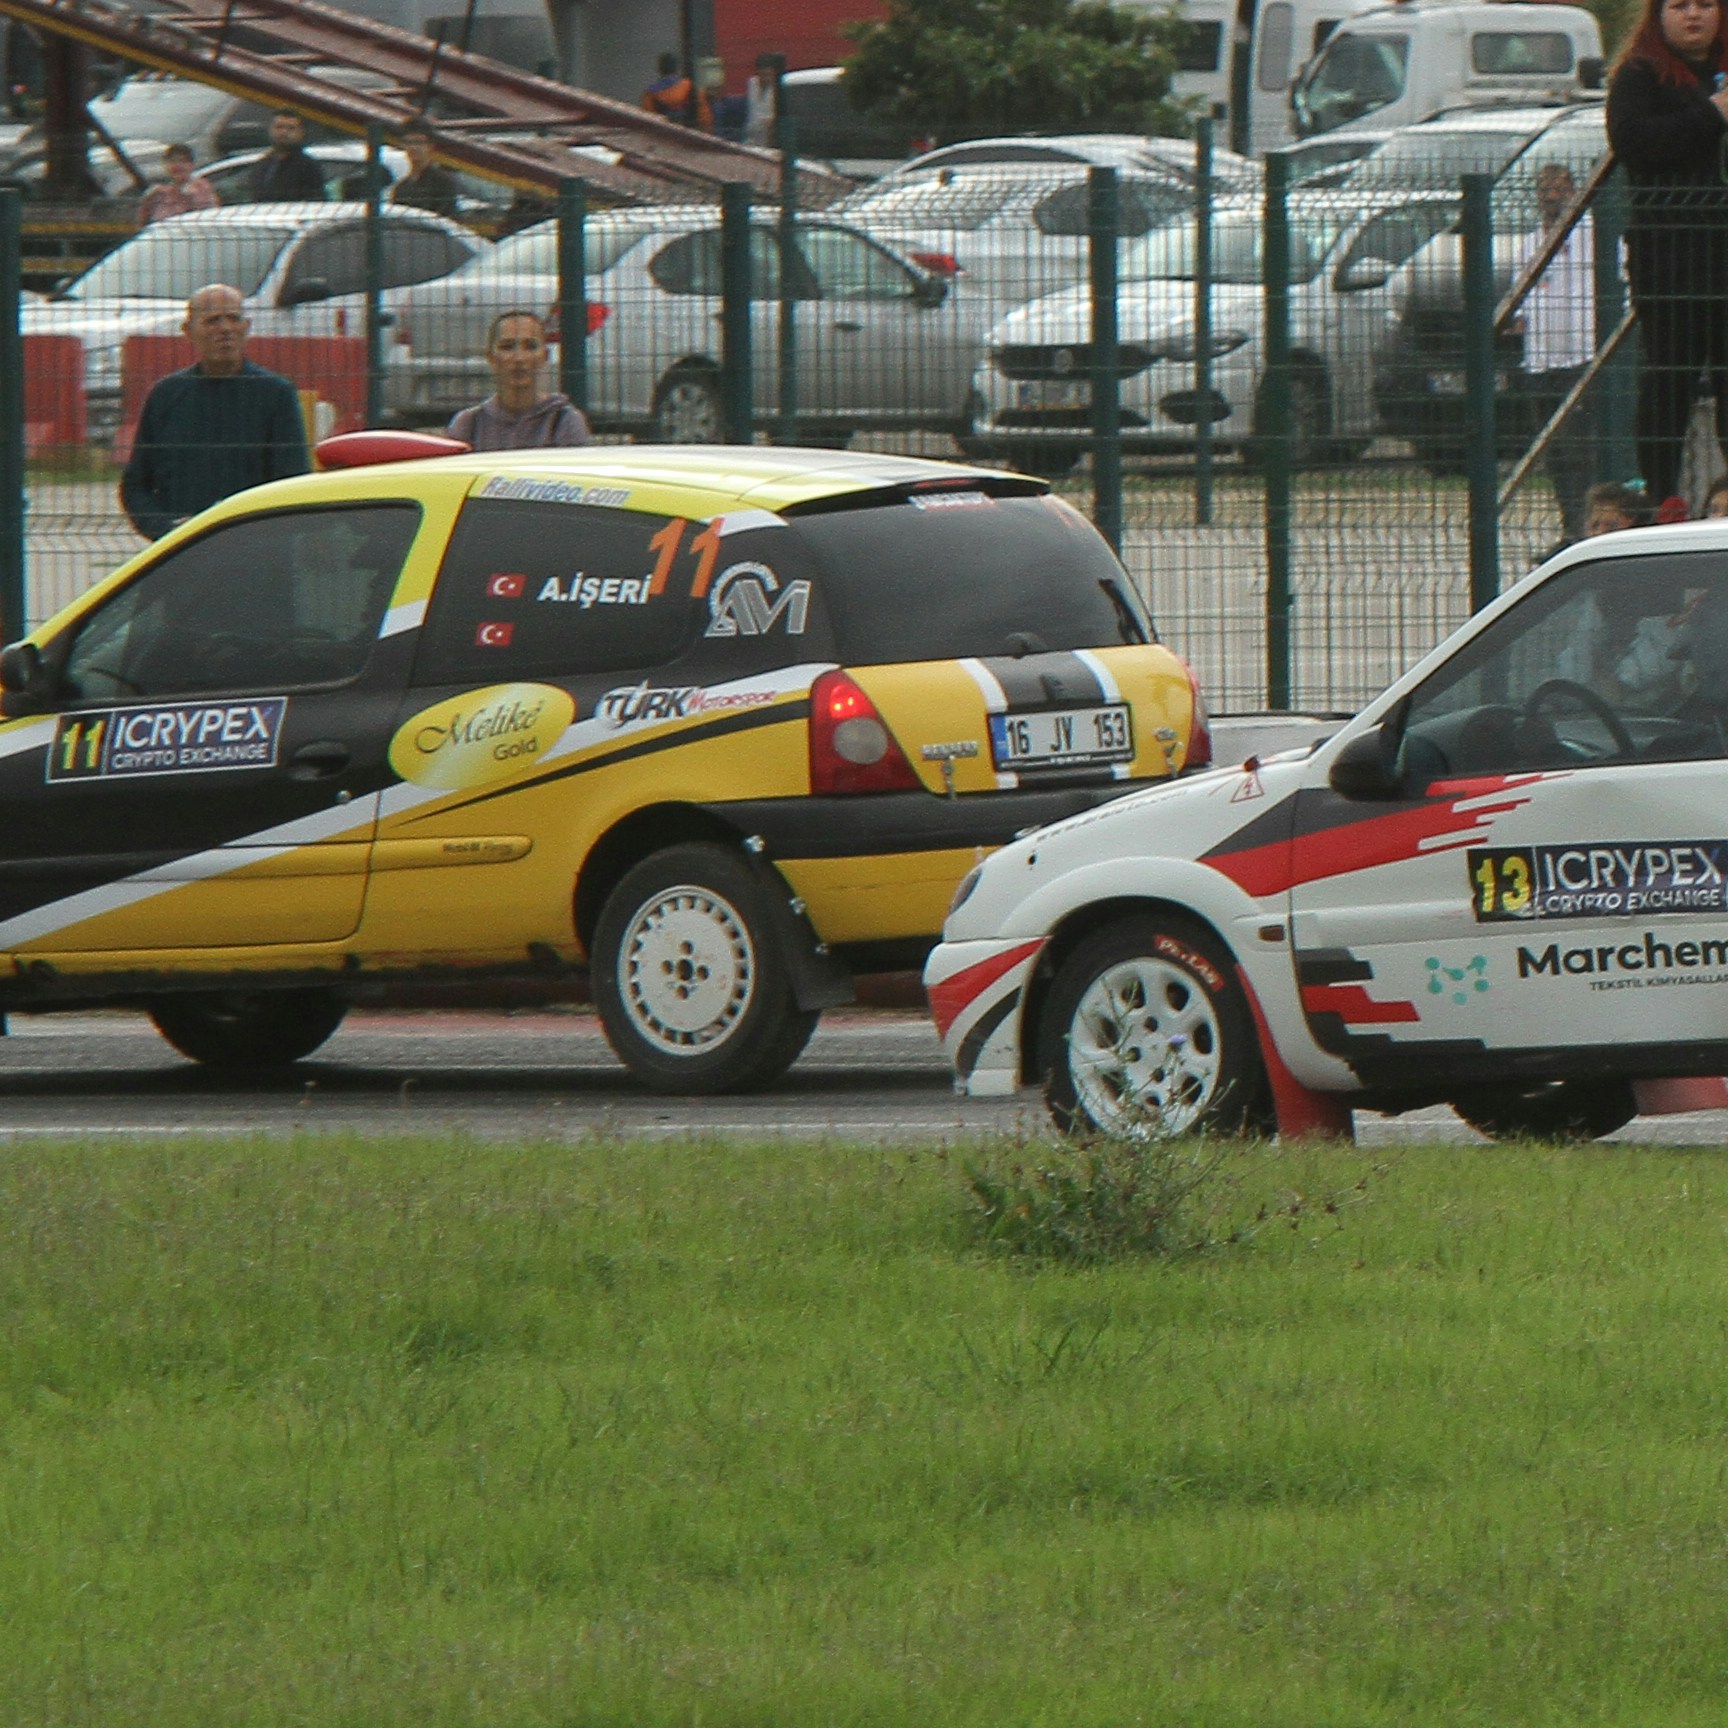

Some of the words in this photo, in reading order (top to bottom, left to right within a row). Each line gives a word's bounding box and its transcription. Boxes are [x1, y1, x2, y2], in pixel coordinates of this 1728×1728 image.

[481, 475, 631, 507] Rallivideo.com
[648, 515, 726, 598] 11
[535, 572, 652, 609] A.İŞERİ
[62, 719, 105, 770] 11
[113, 705, 273, 750] ICRYPEX
[493, 737, 539, 760] Gold
[1007, 720, 1030, 756] 16
[1093, 712, 1127, 749] 153
[112, 749, 176, 769] CRYPTO
[180, 742, 270, 765] EXCHANGE
[1477, 855, 1532, 912] 13
[1543, 847, 1723, 892] ICRYPEX
[1545, 890, 1623, 915] CRYPTO
[1626, 887, 1722, 910] EXCHANGE
